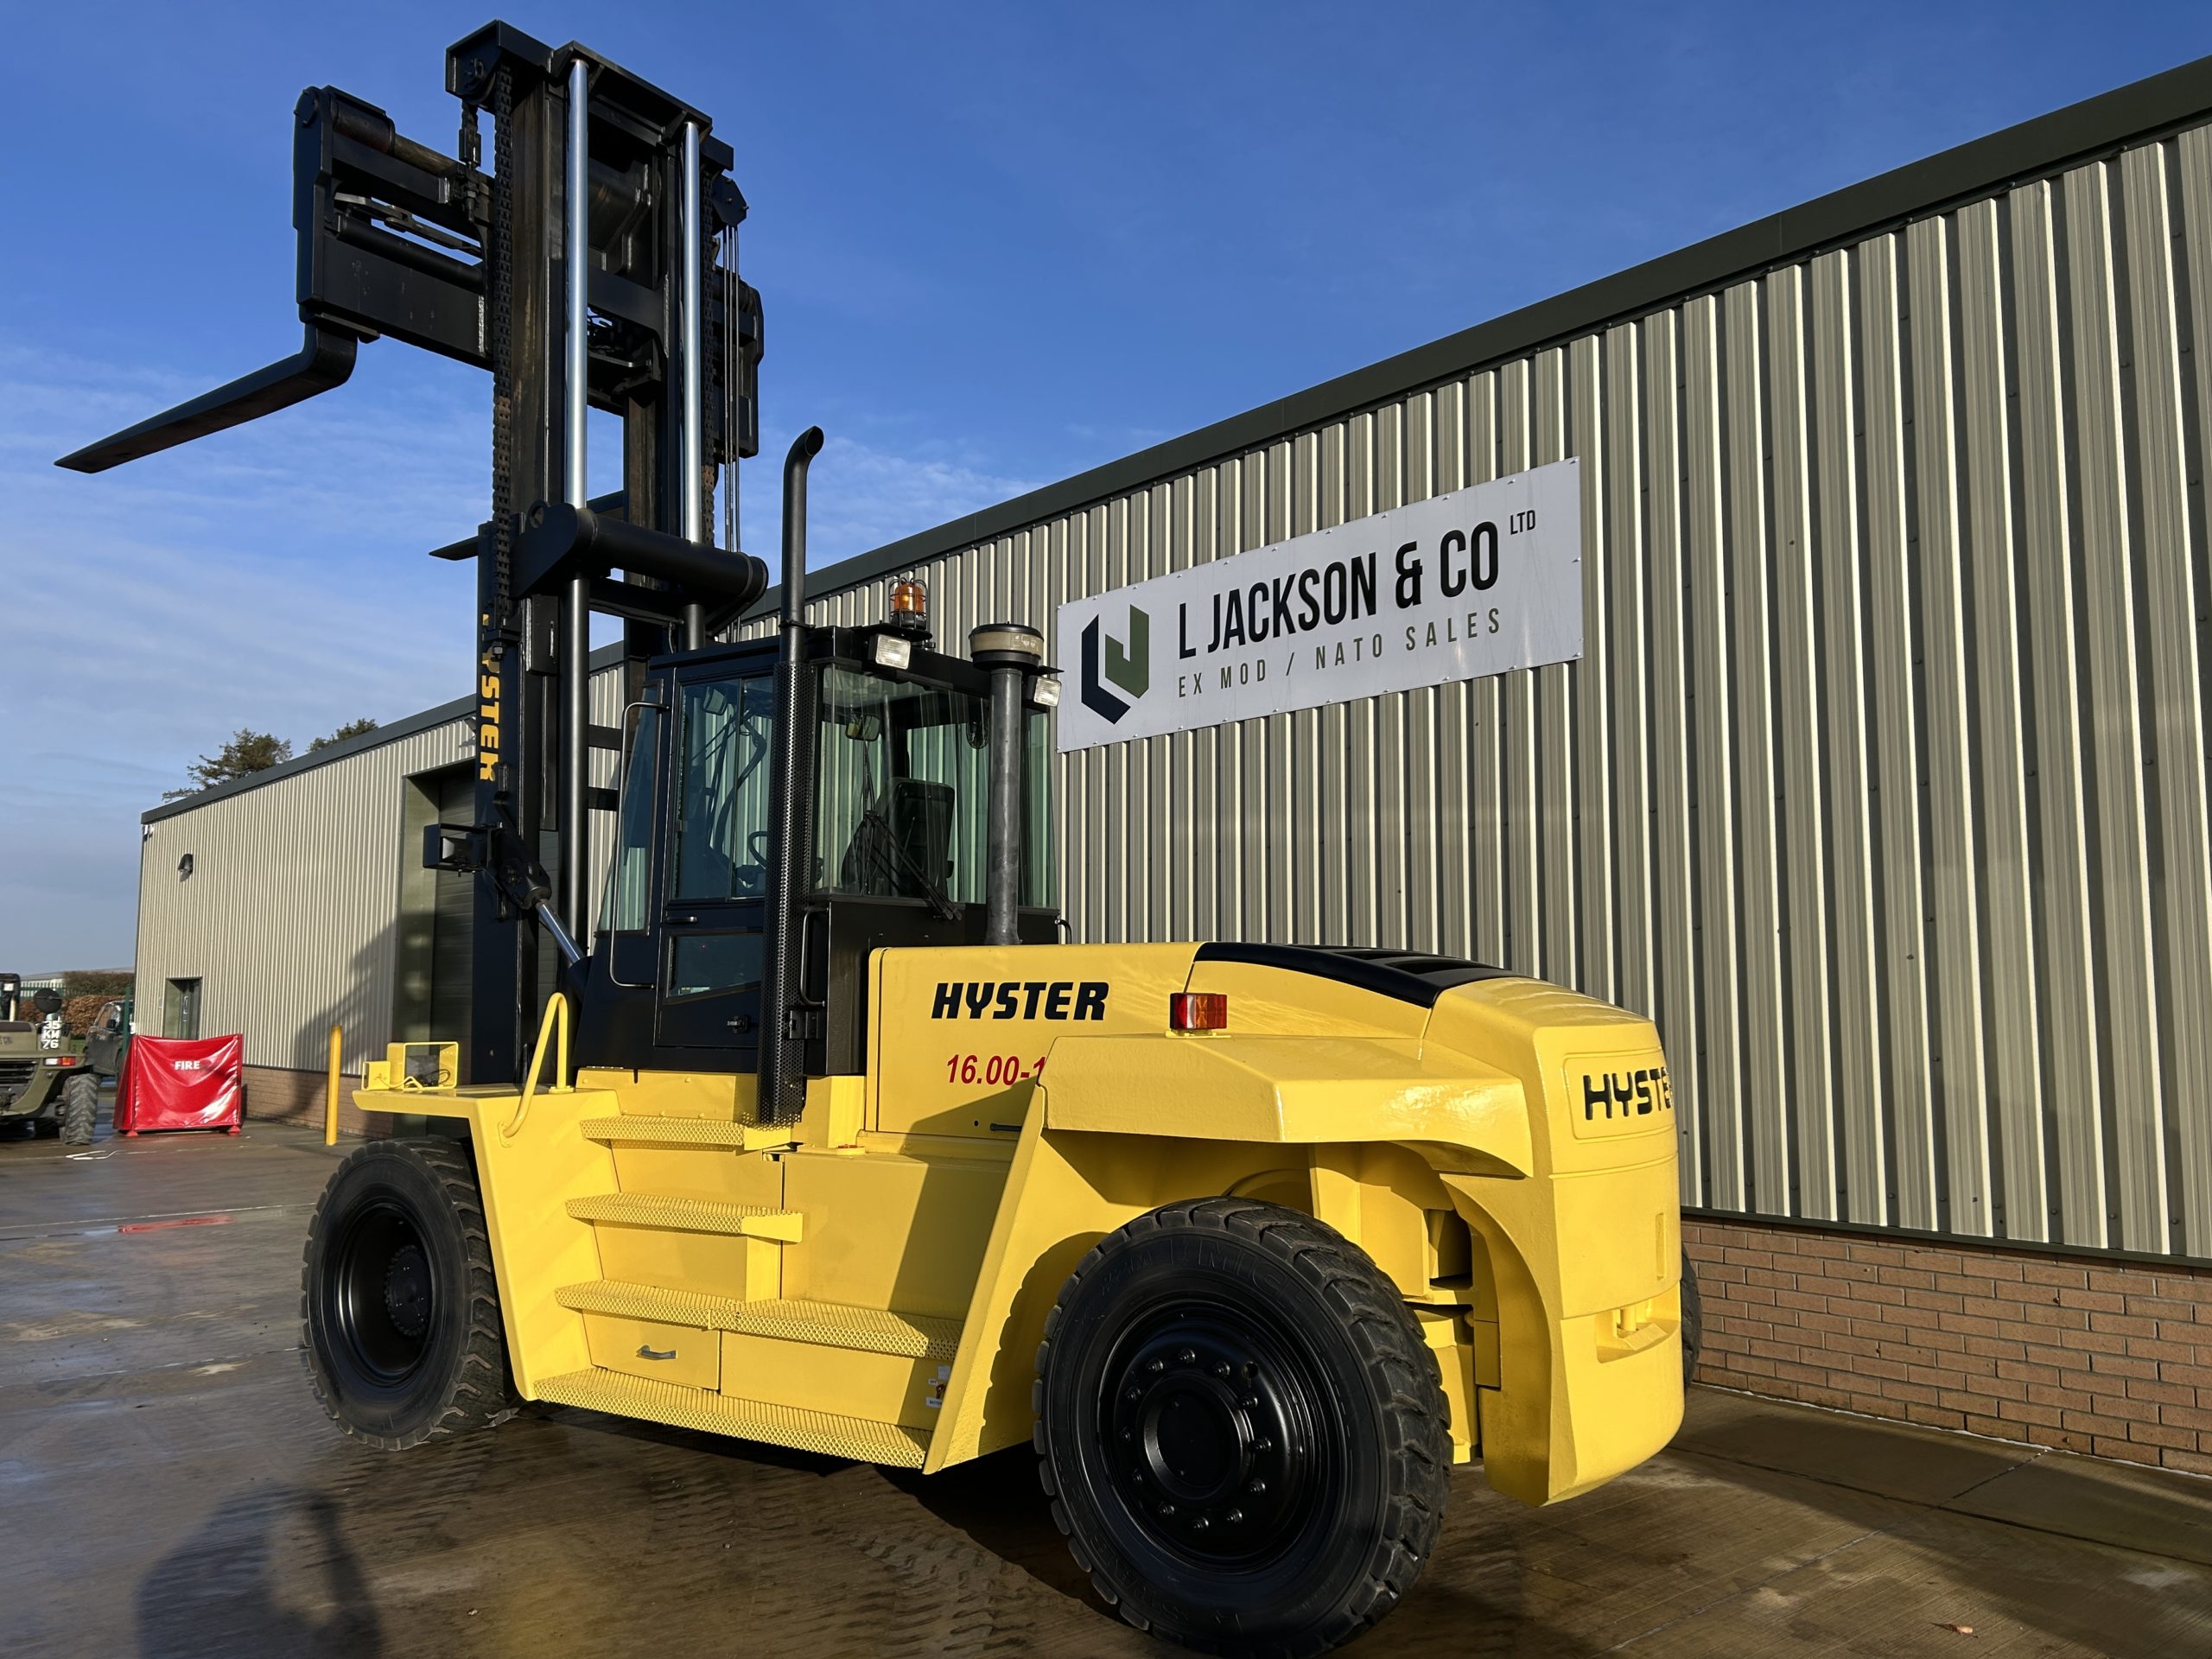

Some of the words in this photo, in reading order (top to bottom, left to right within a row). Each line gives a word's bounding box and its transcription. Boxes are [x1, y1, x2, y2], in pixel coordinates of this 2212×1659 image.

[1179, 602, 1197, 660] L
[1207, 552, 1376, 654] JACKSON
[1395, 541, 1423, 609] &
[1440, 522, 1499, 598] CO
[1510, 510, 1536, 536] LTD
[1179, 672, 1203, 698] EX
[1220, 658, 1267, 690] MOD
[1316, 633, 1382, 671] NATO
[1406, 608, 1502, 652] SALES
[931, 982, 1109, 1021] HYSTER
[43, 1020, 62, 1029] 35
[175, 1060, 200, 1071] FIRE
